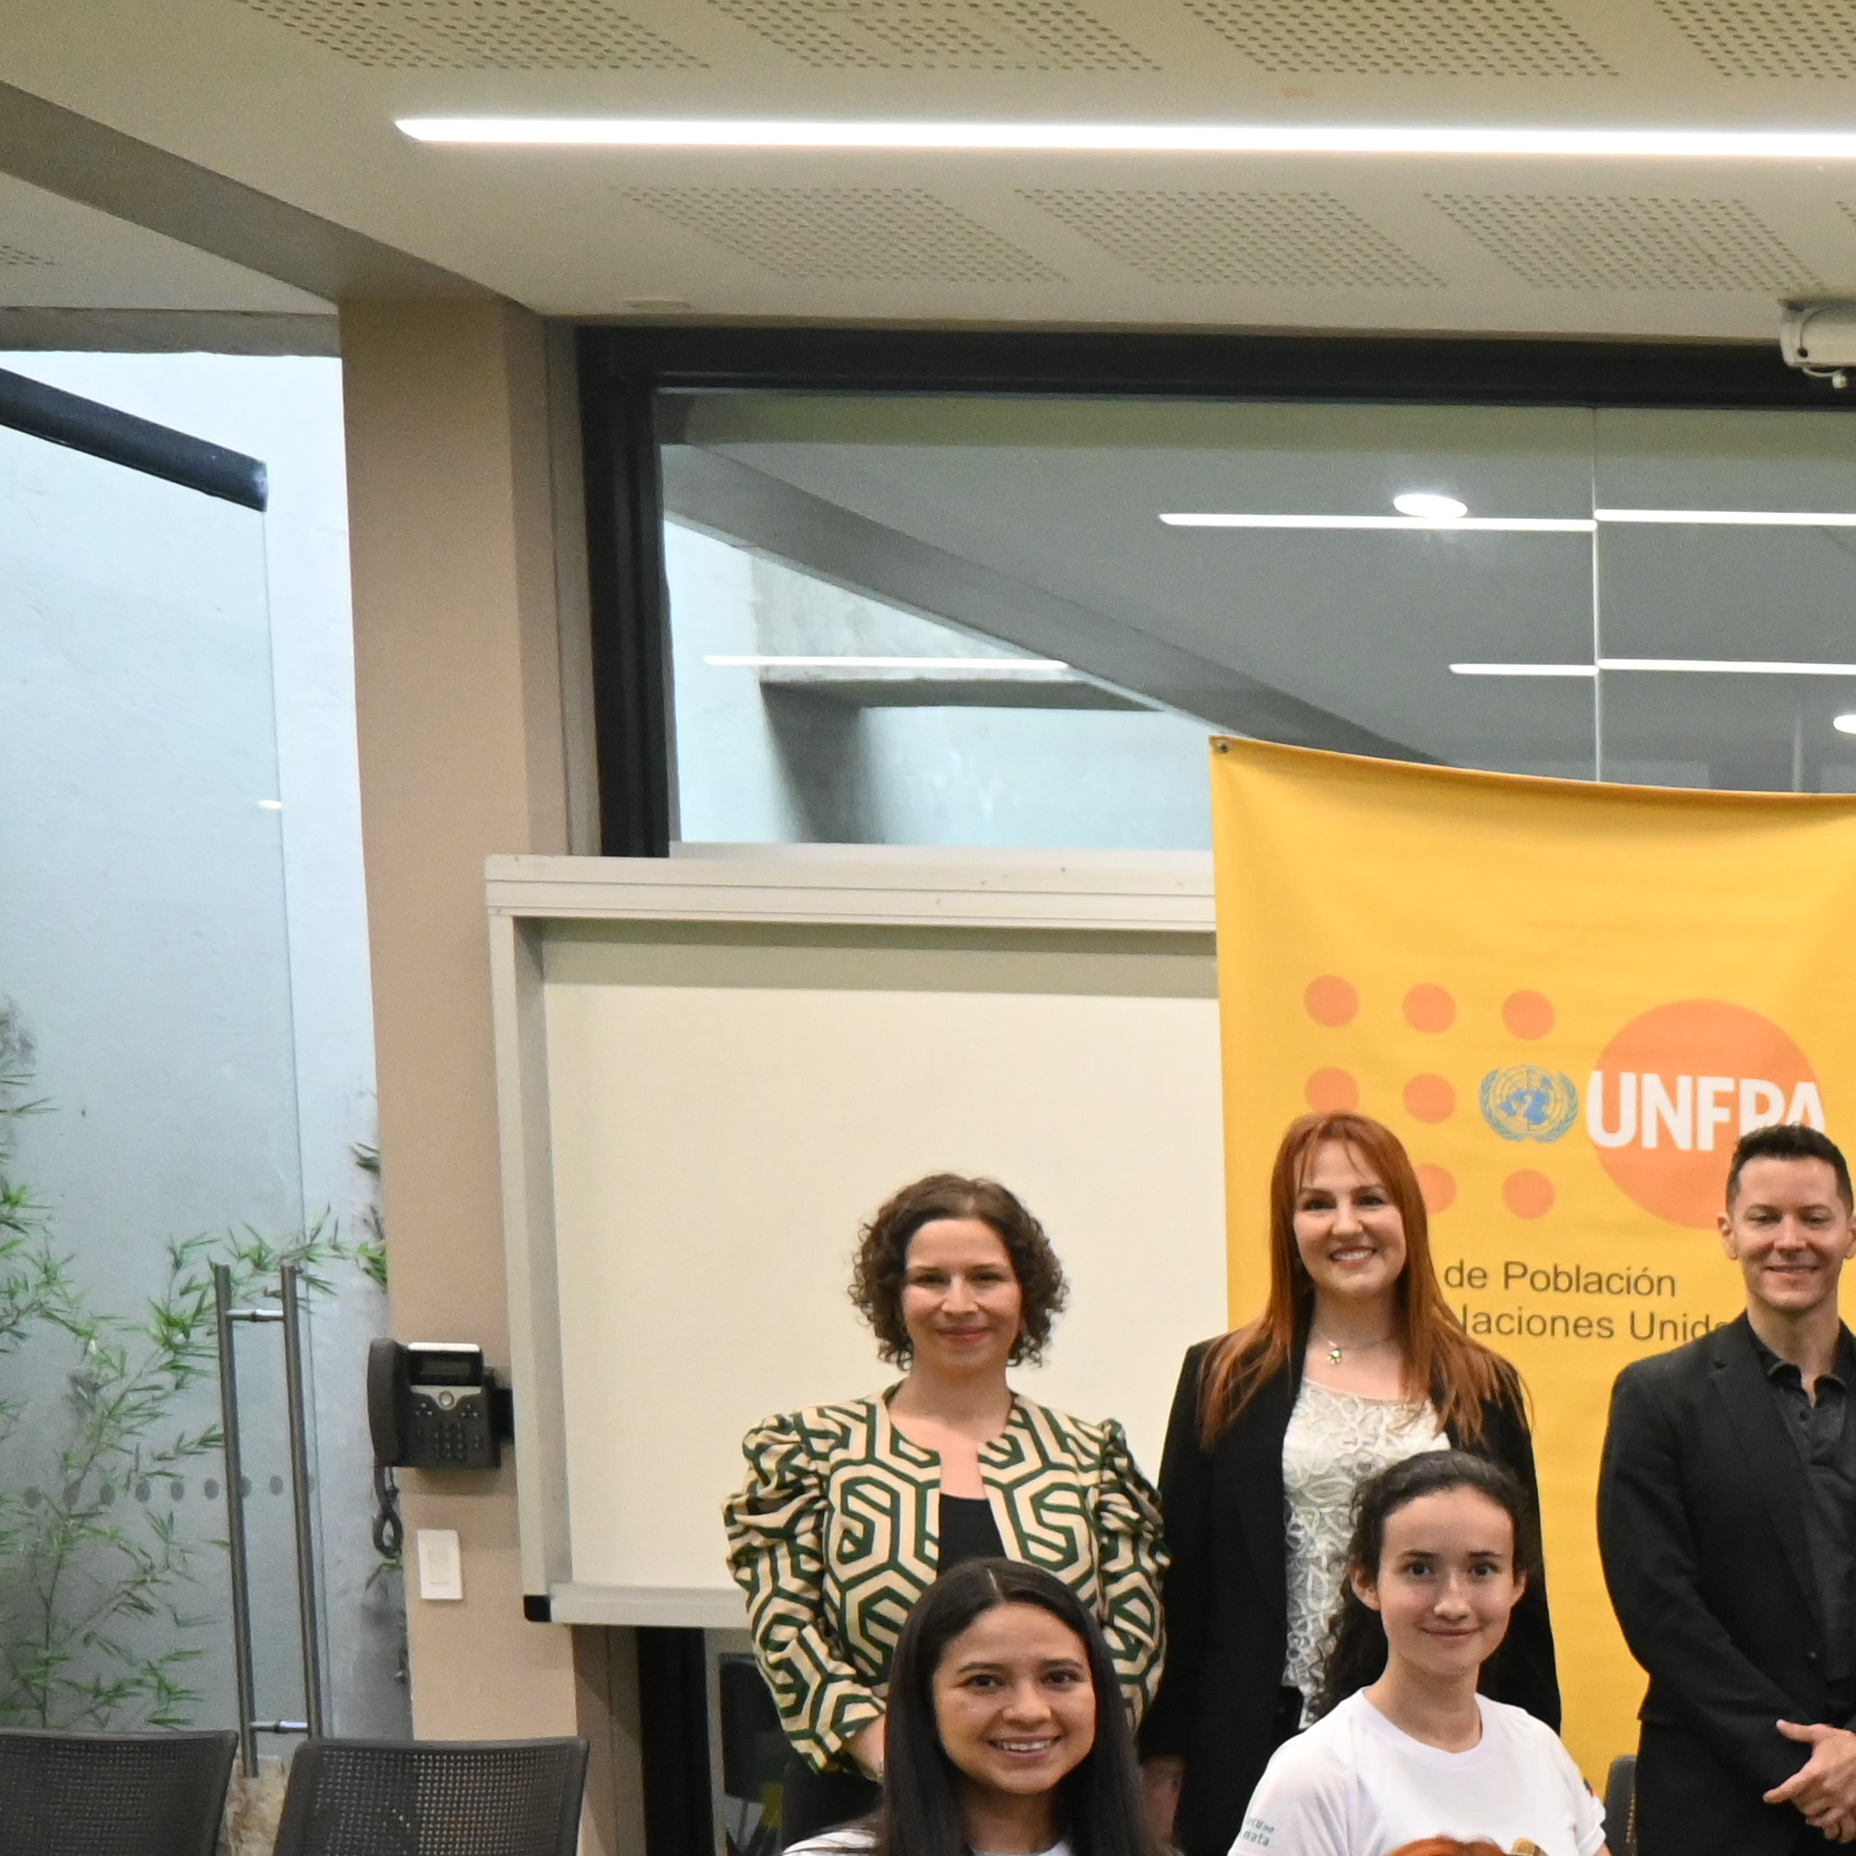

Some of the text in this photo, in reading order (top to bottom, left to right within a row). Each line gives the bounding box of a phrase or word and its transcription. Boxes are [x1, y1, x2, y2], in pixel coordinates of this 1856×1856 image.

[1587, 1071, 1825, 1151] UNFPA
[1443, 1258, 1676, 1298] de Población
[1630, 1311, 1728, 1342] Unid
